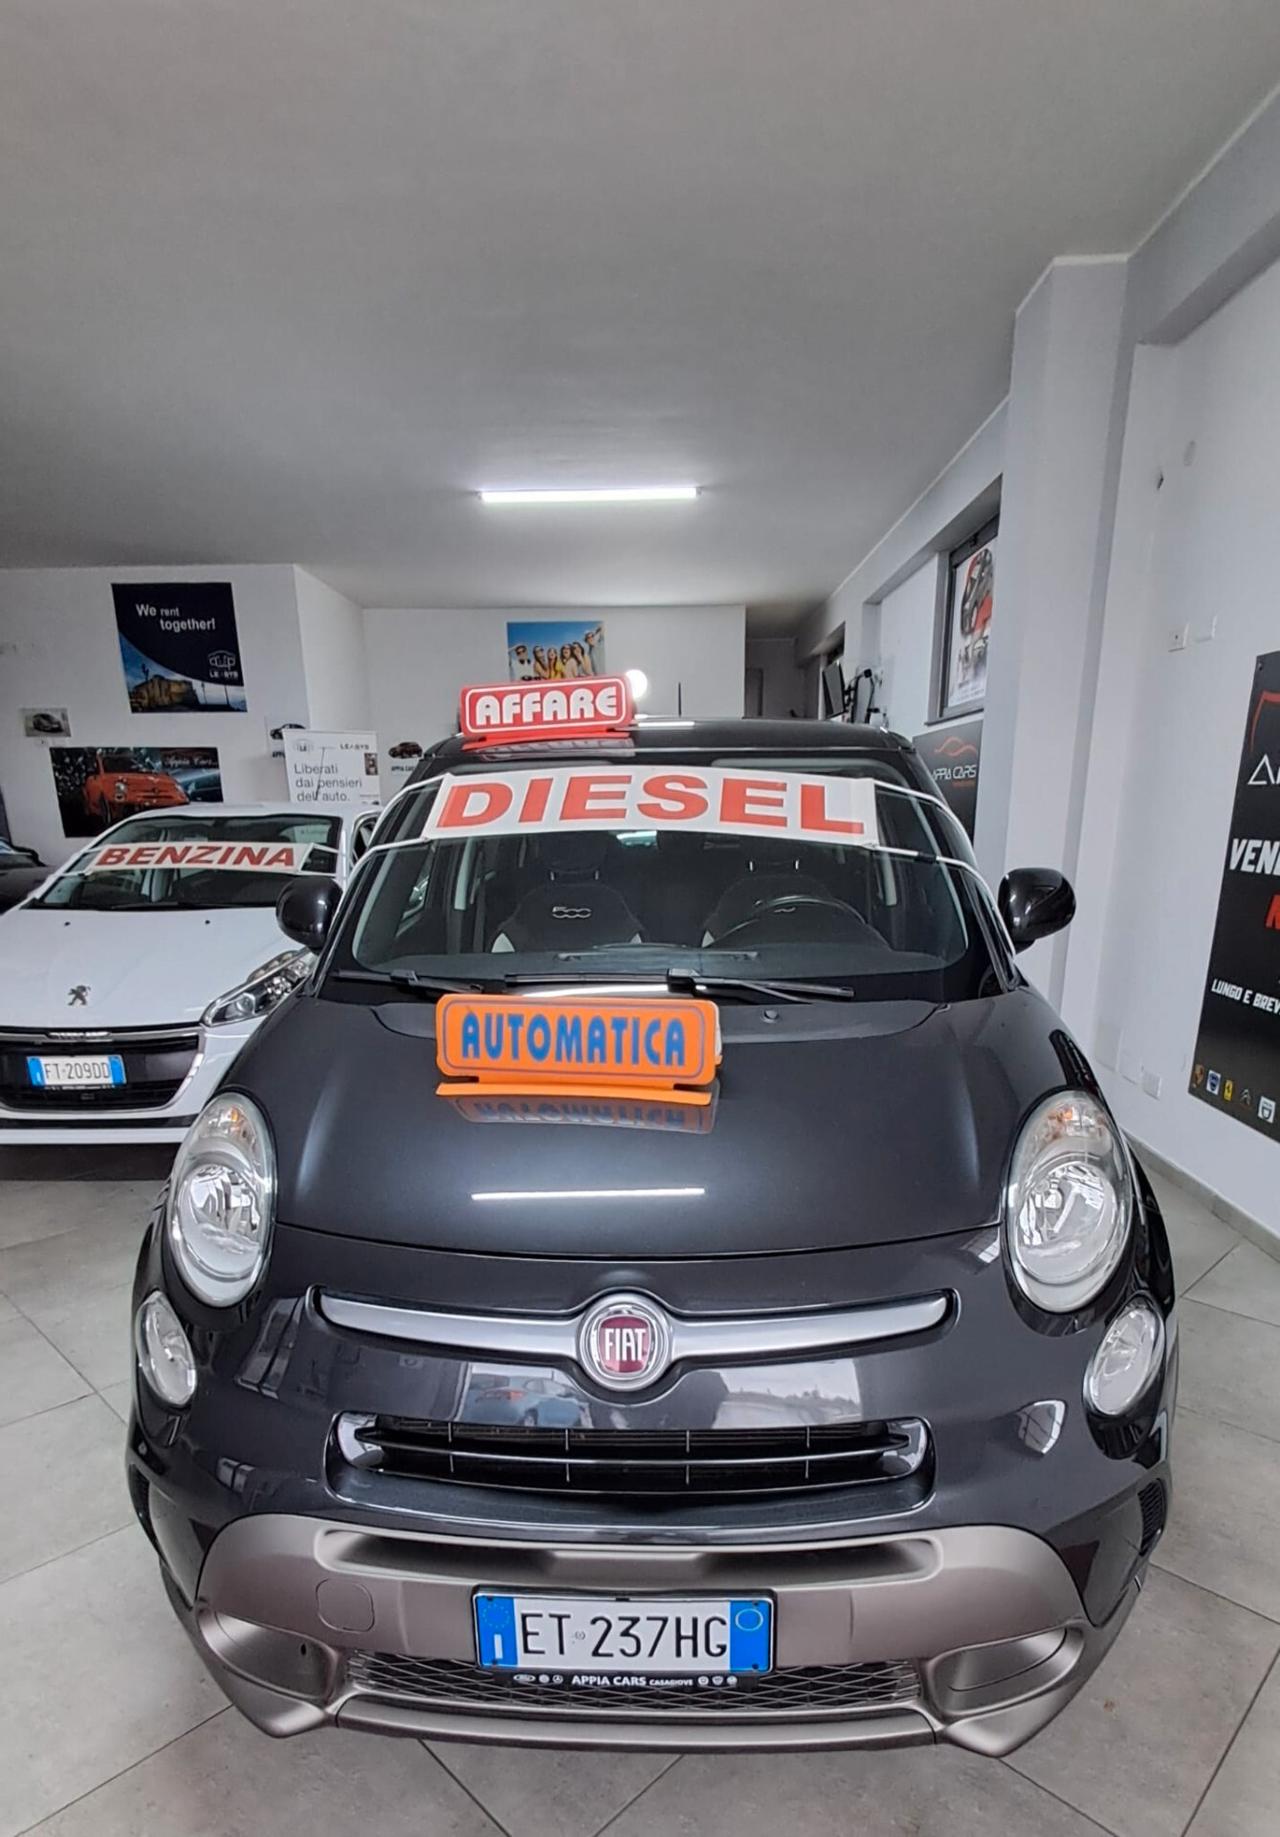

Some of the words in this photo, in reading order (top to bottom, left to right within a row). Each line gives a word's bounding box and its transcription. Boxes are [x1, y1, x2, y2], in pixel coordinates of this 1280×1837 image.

[135, 603, 157, 617] We
[160, 607, 180, 617] rent
[160, 618, 216, 633] together!
[475, 686, 617, 726] AFFARE
[294, 763, 338, 775] Liberati
[295, 779, 314, 788] dai
[318, 779, 362, 790] pensieri
[436, 775, 865, 834] DIESEL
[99, 846, 295, 867] BENZINA
[1211, 978, 1243, 1001] LUNGO
[1243, 989, 1253, 1004] E
[1252, 992, 1280, 1015] BREV
[461, 1010, 685, 1067] AUTOMATICA
[44, 1063, 61, 1080] FT
[65, 1062, 110, 1080] 209DD
[604, 1327, 647, 1362] FIAT
[520, 1613, 571, 1655] ET
[590, 1616, 728, 1658] 237HG
[571, 1675, 611, 1685] APPIA
[613, 1676, 646, 1686] CARS
